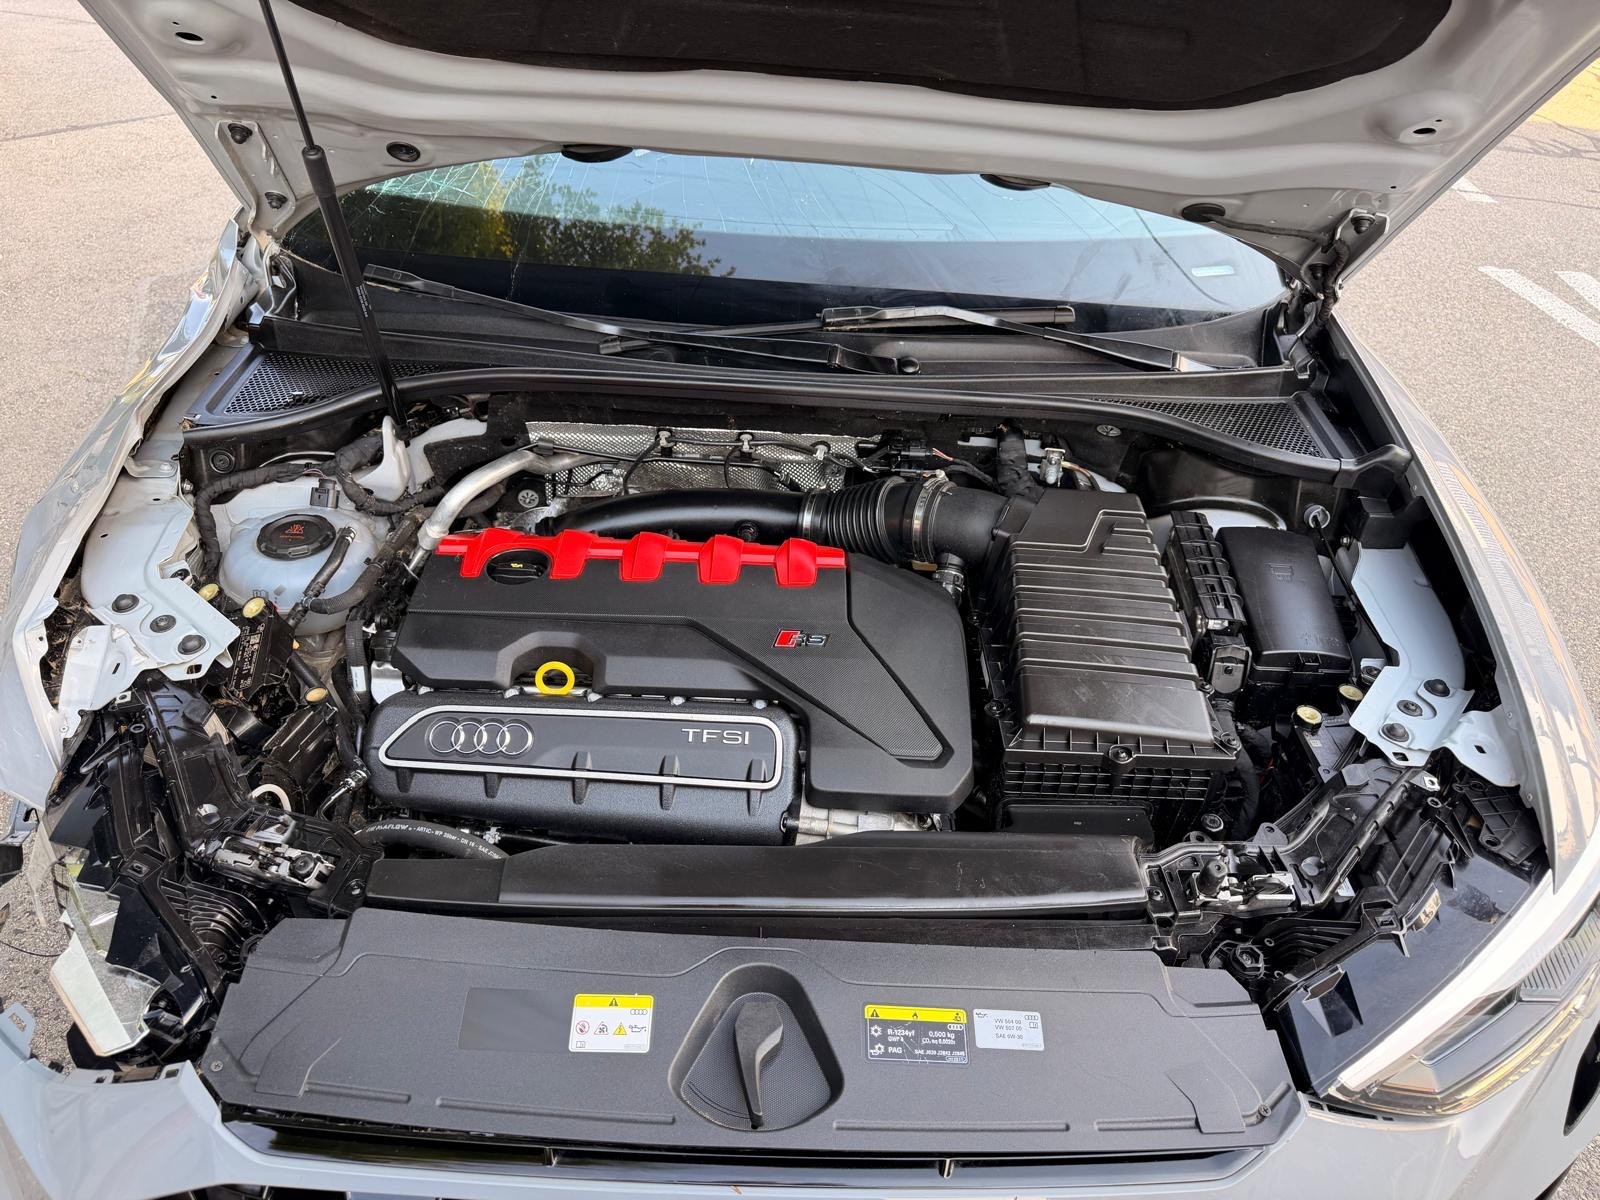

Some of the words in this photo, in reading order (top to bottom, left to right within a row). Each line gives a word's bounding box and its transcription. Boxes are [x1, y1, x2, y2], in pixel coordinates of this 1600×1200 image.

[778, 630, 829, 647] RS
[681, 728, 750, 745] TFSI
[887, 1029, 915, 1037] R-1234yf
